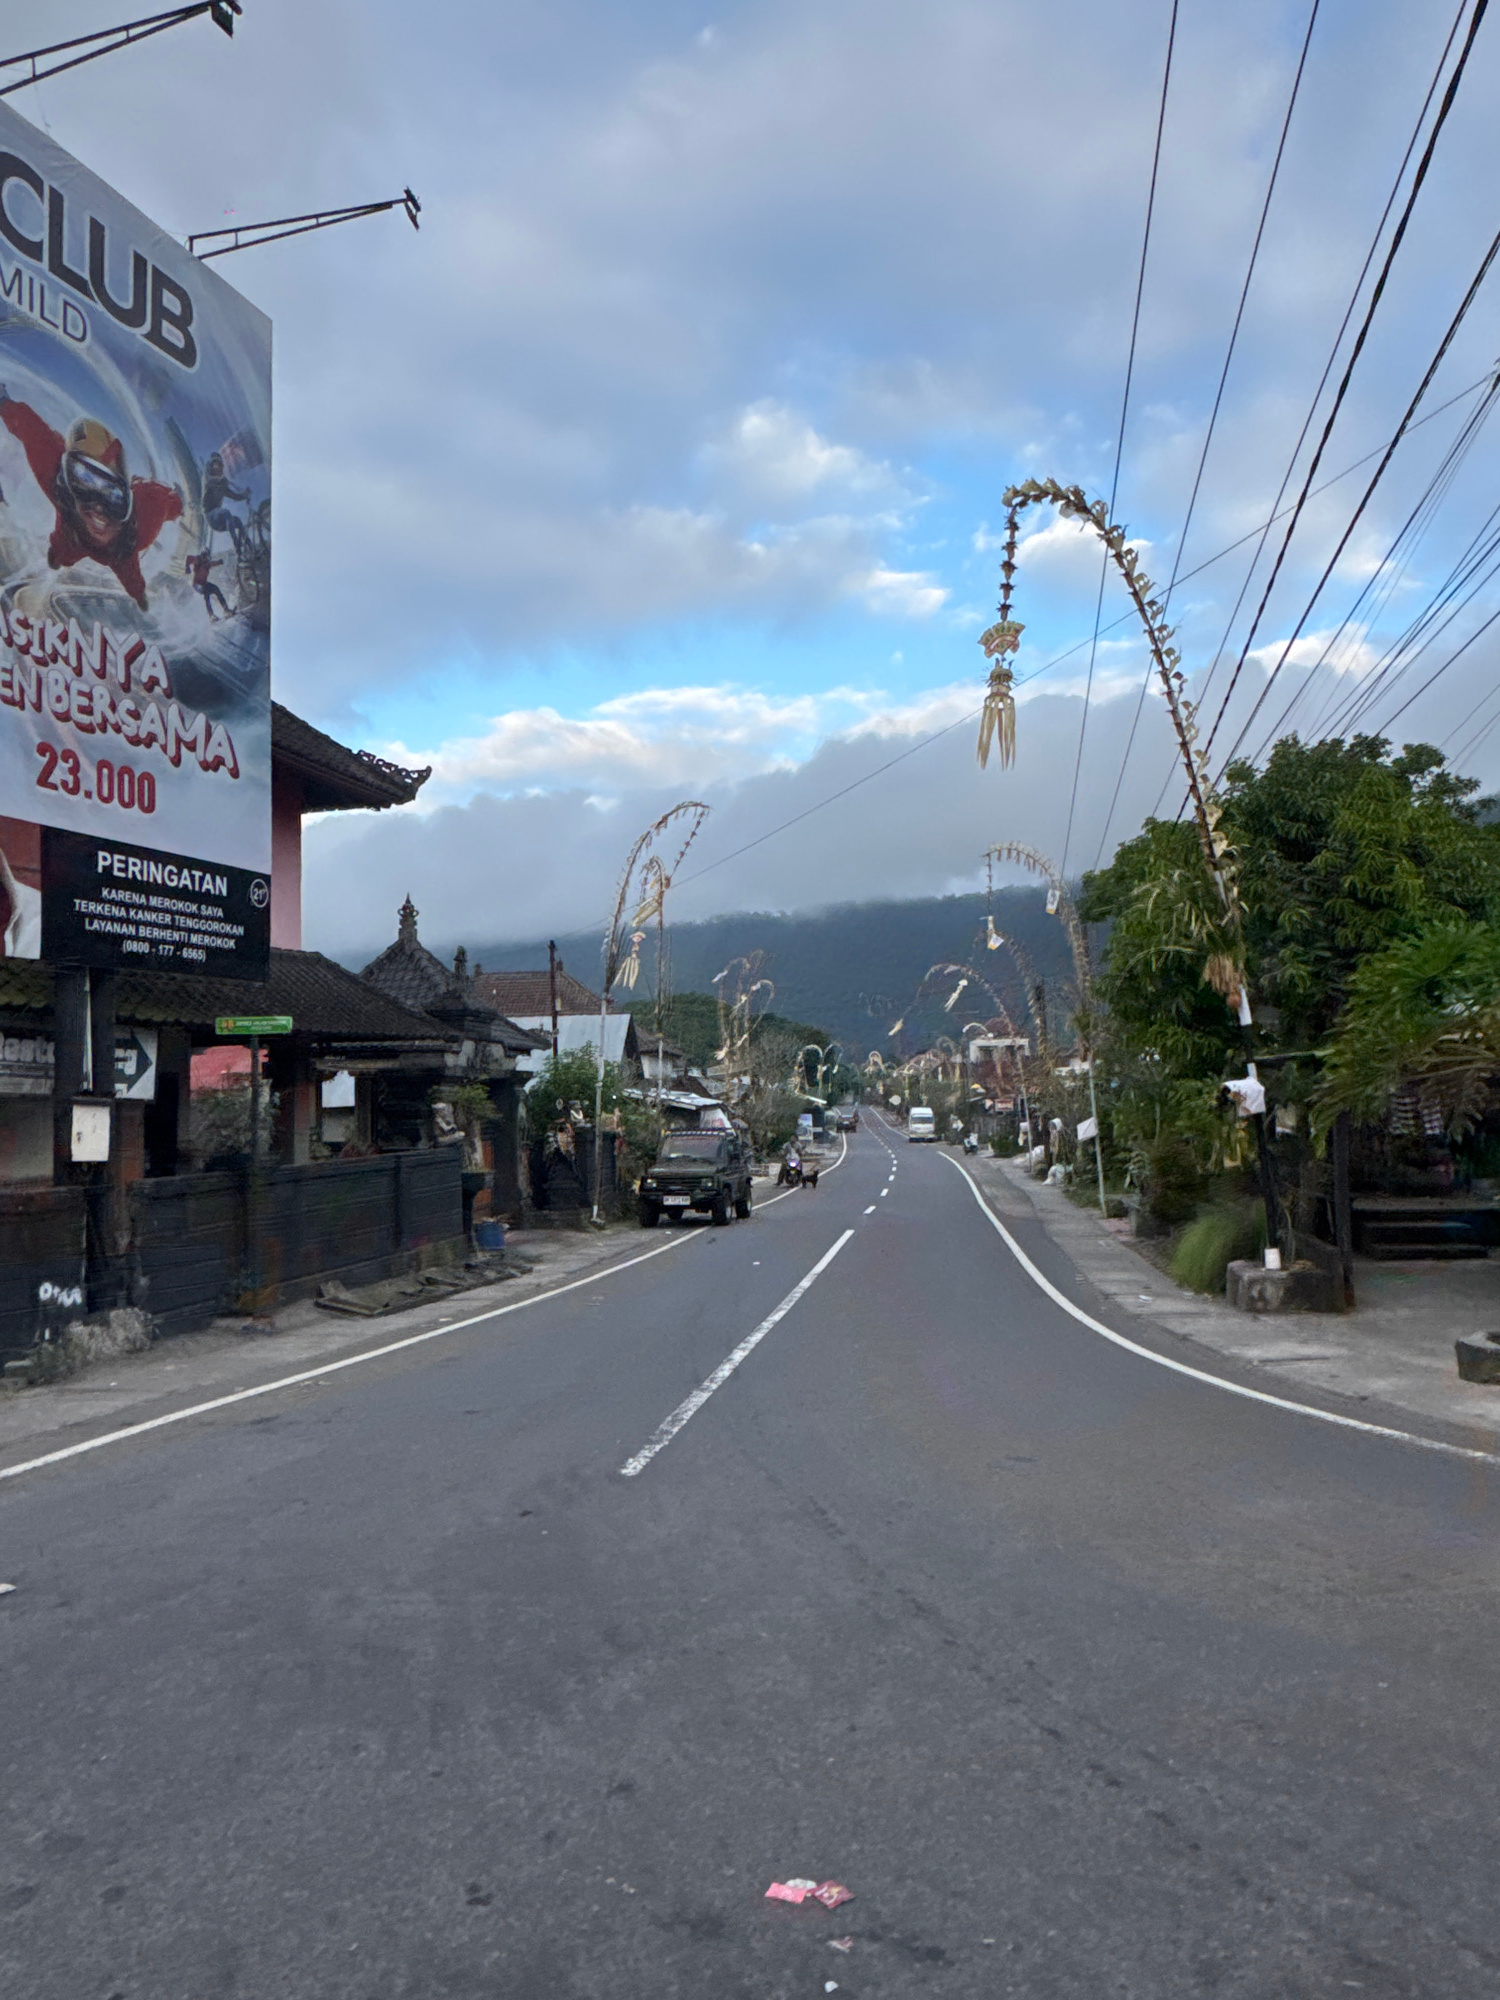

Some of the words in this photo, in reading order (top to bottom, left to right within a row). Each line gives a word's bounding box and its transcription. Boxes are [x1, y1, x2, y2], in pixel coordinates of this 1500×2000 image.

[0, 151, 197, 369] CLUB
[0, 263, 88, 344] MILD
[47, 668, 240, 779] BERSAMA
[36, 741, 157, 814] 23.000
[97, 851, 227, 896] PERINGATAN
[73, 898, 126, 918] TERKENA
[129, 907, 172, 926] KANKER
[174, 916, 244, 936] TENGGOROKAN
[101, 886, 146, 905] KARENA
[149, 895, 198, 915] MEROKOK
[200, 904, 224, 919] SAYA
[85, 918, 136, 935] LAYANAN
[138, 926, 188, 944] BERHENTI
[190, 932, 236, 949] MEROKOK
[122, 939, 149, 953] (0800
[158, 943, 174, 957] 177
[182, 947, 206, 962] 6565)
